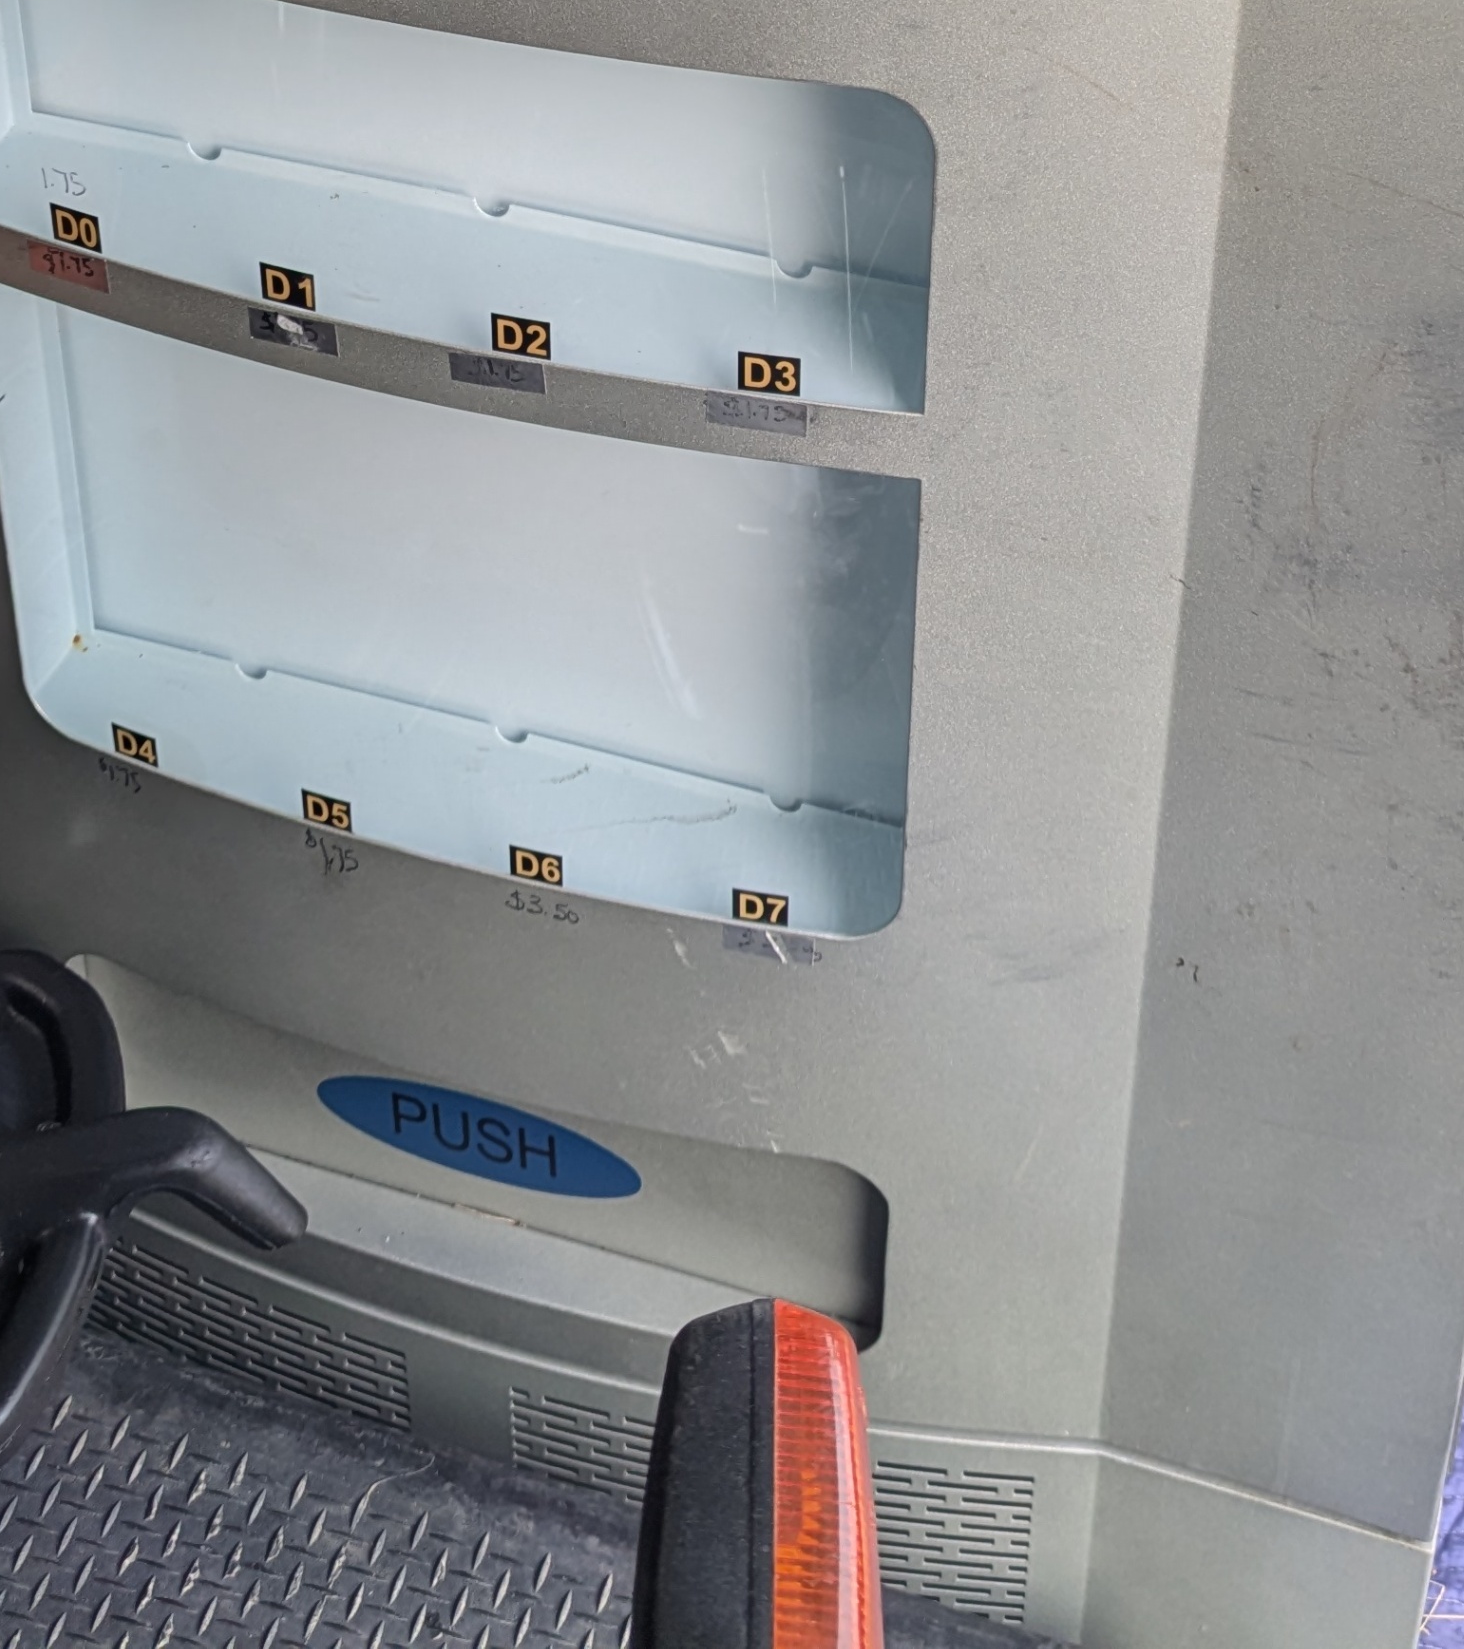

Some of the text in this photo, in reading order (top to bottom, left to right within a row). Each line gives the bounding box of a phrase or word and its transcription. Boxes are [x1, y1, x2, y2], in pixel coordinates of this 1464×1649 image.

[41, 167, 87, 196] 1.75
[55, 208, 98, 248] D0
[265, 268, 313, 308] D1
[497, 318, 547, 356] D2
[744, 356, 796, 392] D3
[116, 729, 156, 764] D4
[306, 794, 350, 829] D5
[516, 850, 561, 883] D6
[505, 890, 580, 924] $3.50
[739, 893, 786, 923] D7
[391, 1092, 557, 1178] PUSH
